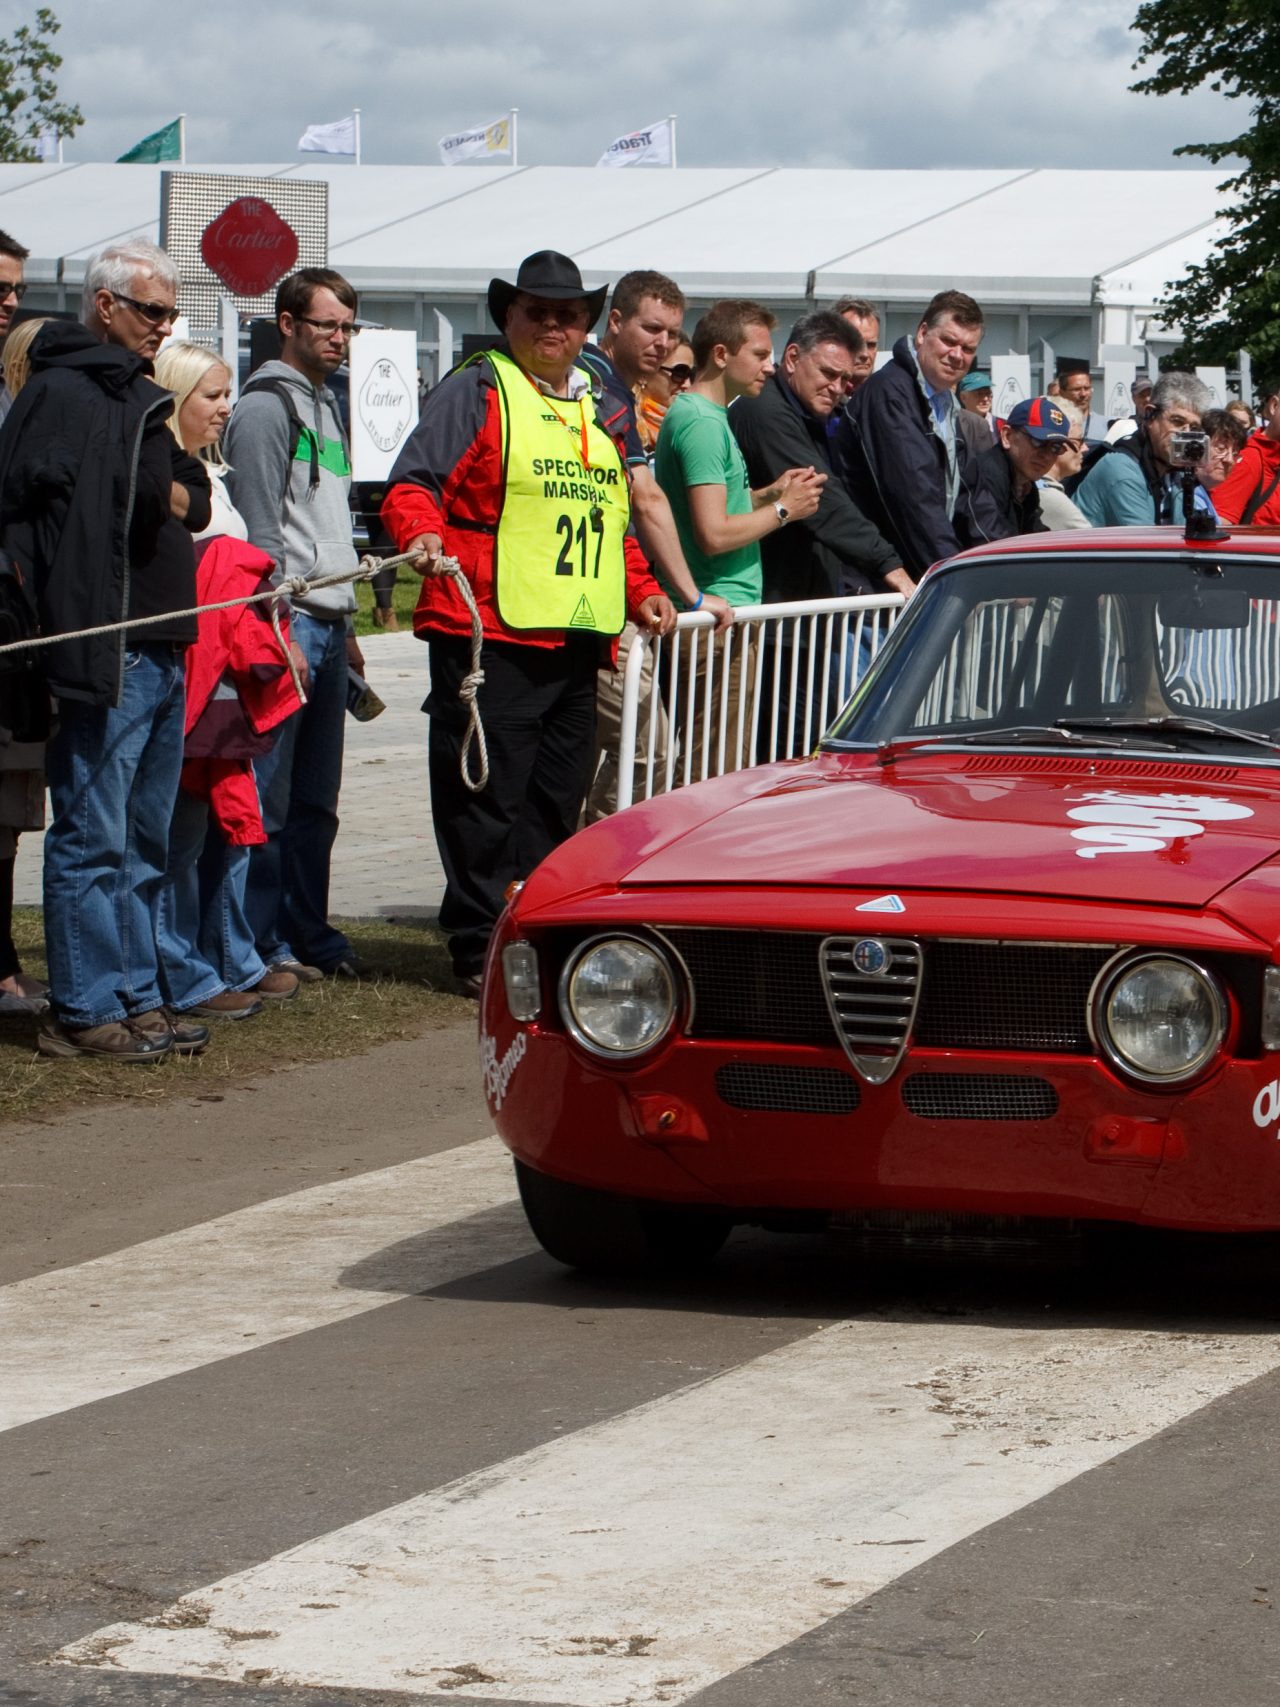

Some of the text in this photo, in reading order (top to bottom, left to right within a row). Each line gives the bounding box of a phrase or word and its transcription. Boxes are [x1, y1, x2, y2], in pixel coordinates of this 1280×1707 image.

[240, 201, 262, 217] THE
[215, 220, 286, 249] Cartier
[378, 364, 391, 378] THE
[366, 381, 405, 407] Cartier
[555, 514, 604, 579] 217
